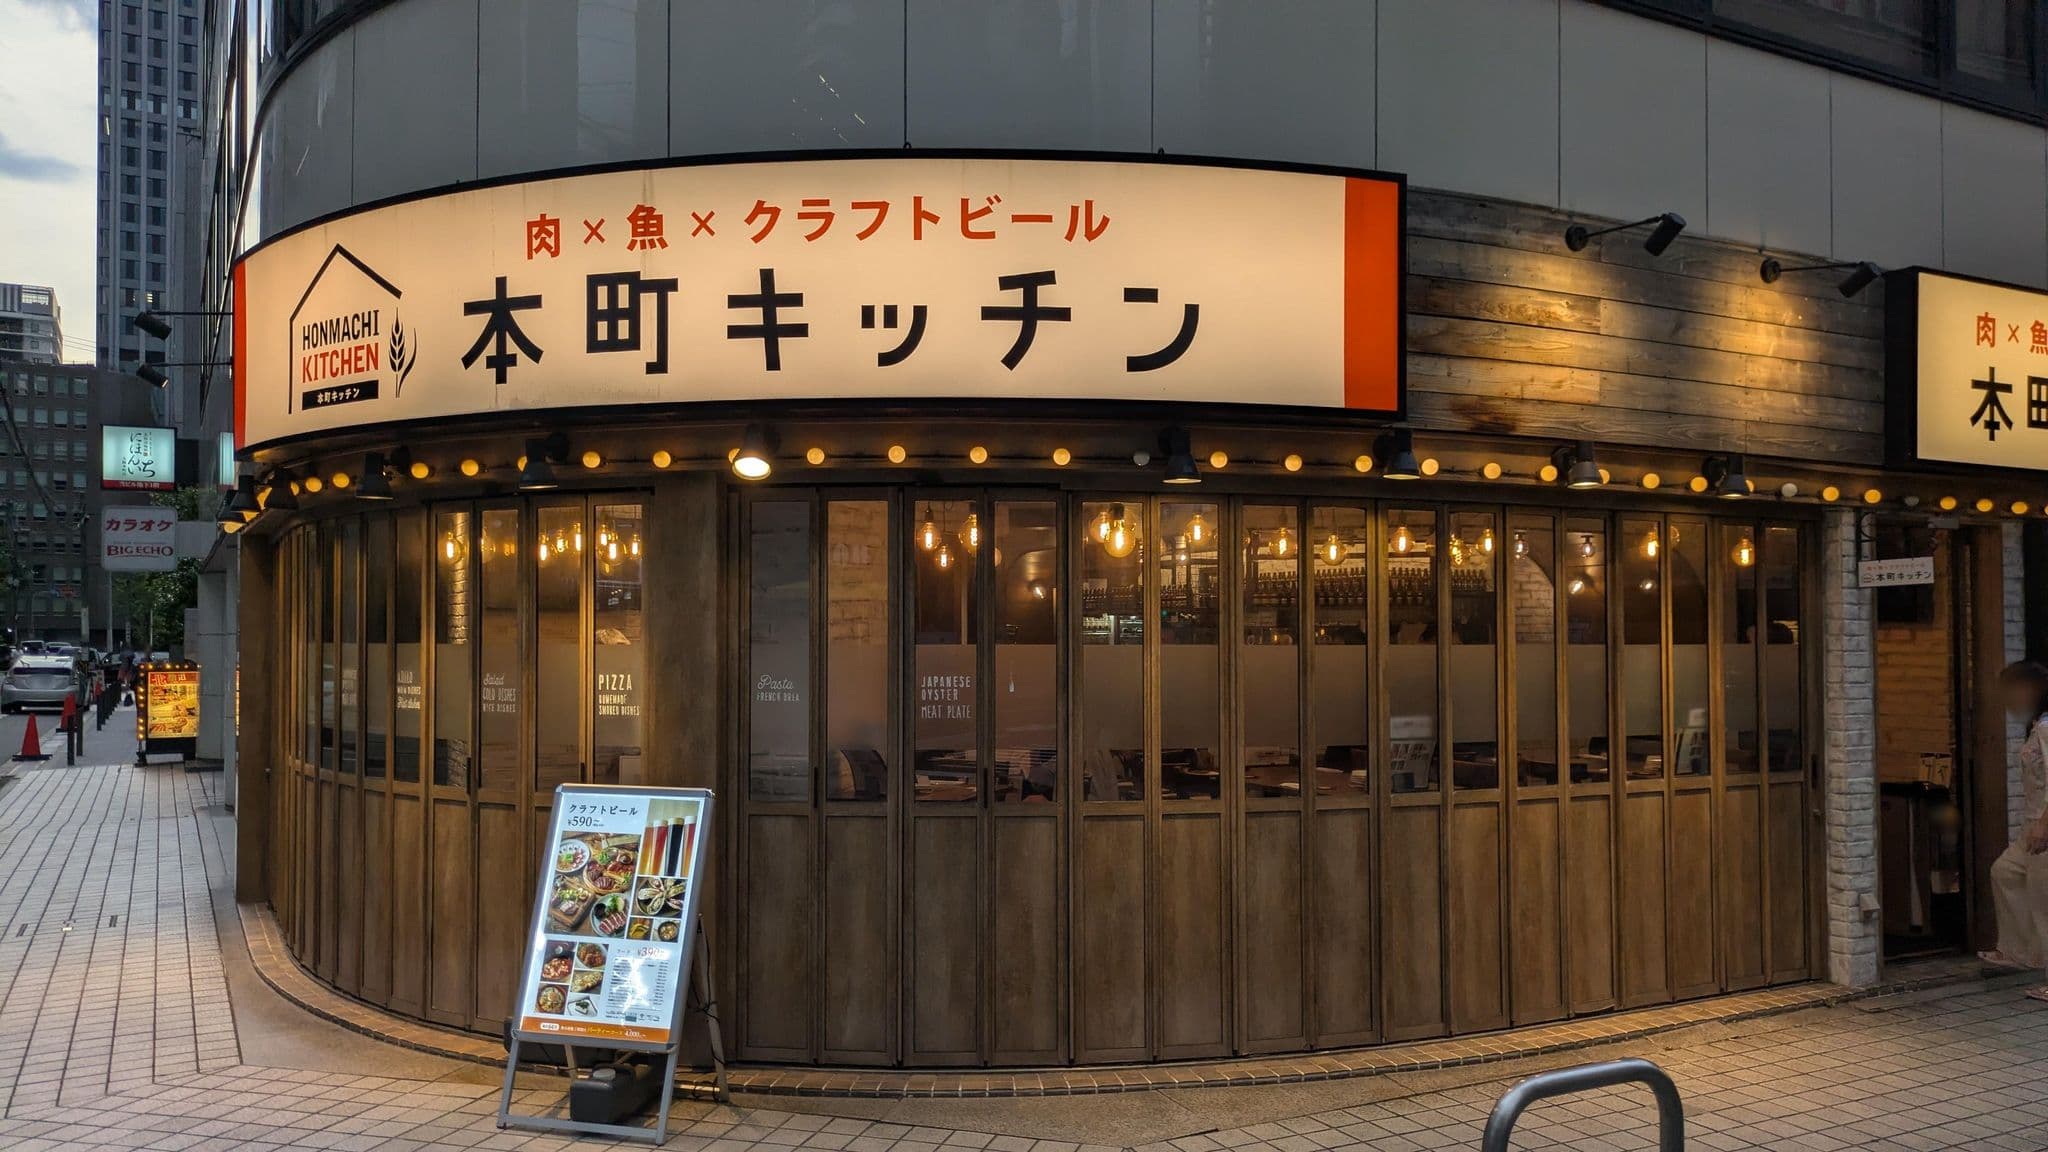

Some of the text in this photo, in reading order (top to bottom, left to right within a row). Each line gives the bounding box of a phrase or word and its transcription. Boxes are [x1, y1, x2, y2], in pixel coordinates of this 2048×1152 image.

[303, 310, 379, 351] HONMACHI
[461, 268, 1199, 384] 本町キッチン
[303, 342, 378, 383] KITCHEN
[106, 519, 173, 531] カラオケ
[107, 545, 174, 557] BIG ECHO
[1876, 571, 1931, 581] 本町キッチン
[599, 674, 632, 690] PIZZA
[757, 674, 794, 689] Pasta
[921, 675, 971, 688] JAPANESE
[921, 688, 959, 701] OYSTER
[599, 705, 640, 716] SMOKED DISHES
[921, 704, 972, 719] MEAT PLATE
[569, 804, 638, 815] クラフトビール
